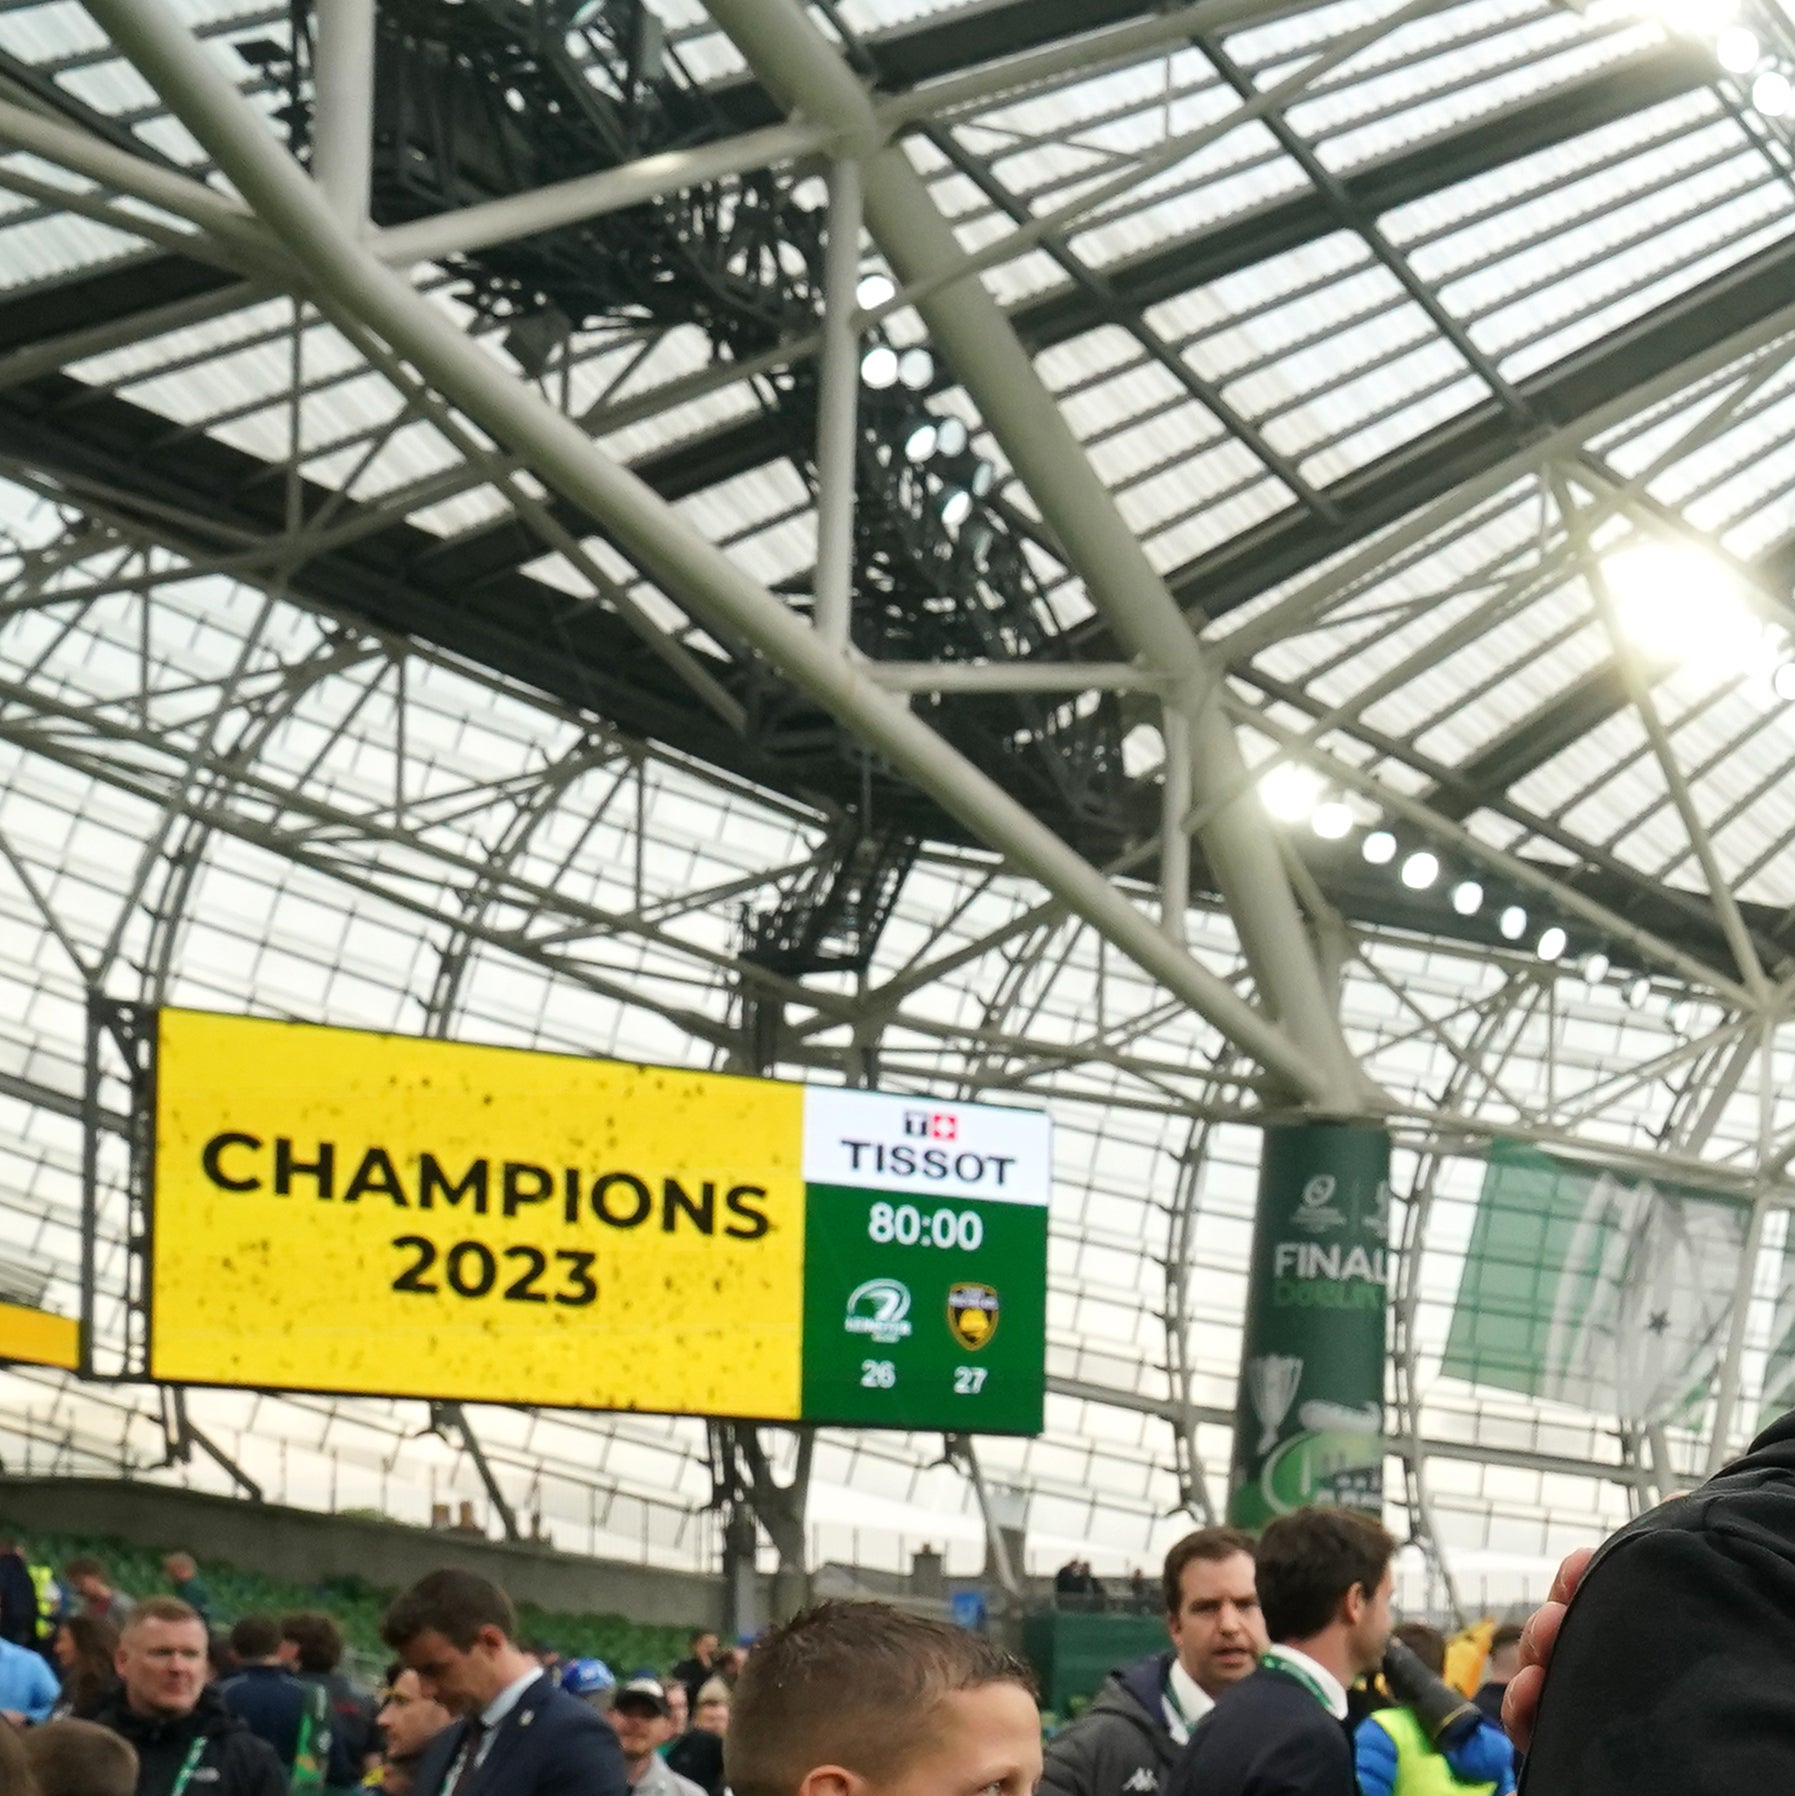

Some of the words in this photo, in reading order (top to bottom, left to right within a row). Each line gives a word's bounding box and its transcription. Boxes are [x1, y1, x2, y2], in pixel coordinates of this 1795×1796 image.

[200, 1131, 771, 1240] CHAMPIONS
[841, 1140, 1016, 1185] TISSOT
[868, 1201, 984, 1251] 80:00
[392, 1235, 598, 1306] 2023
[1273, 1241, 1388, 1285] FINAL
[861, 1359, 896, 1389] 26
[953, 1366, 988, 1394] 27
